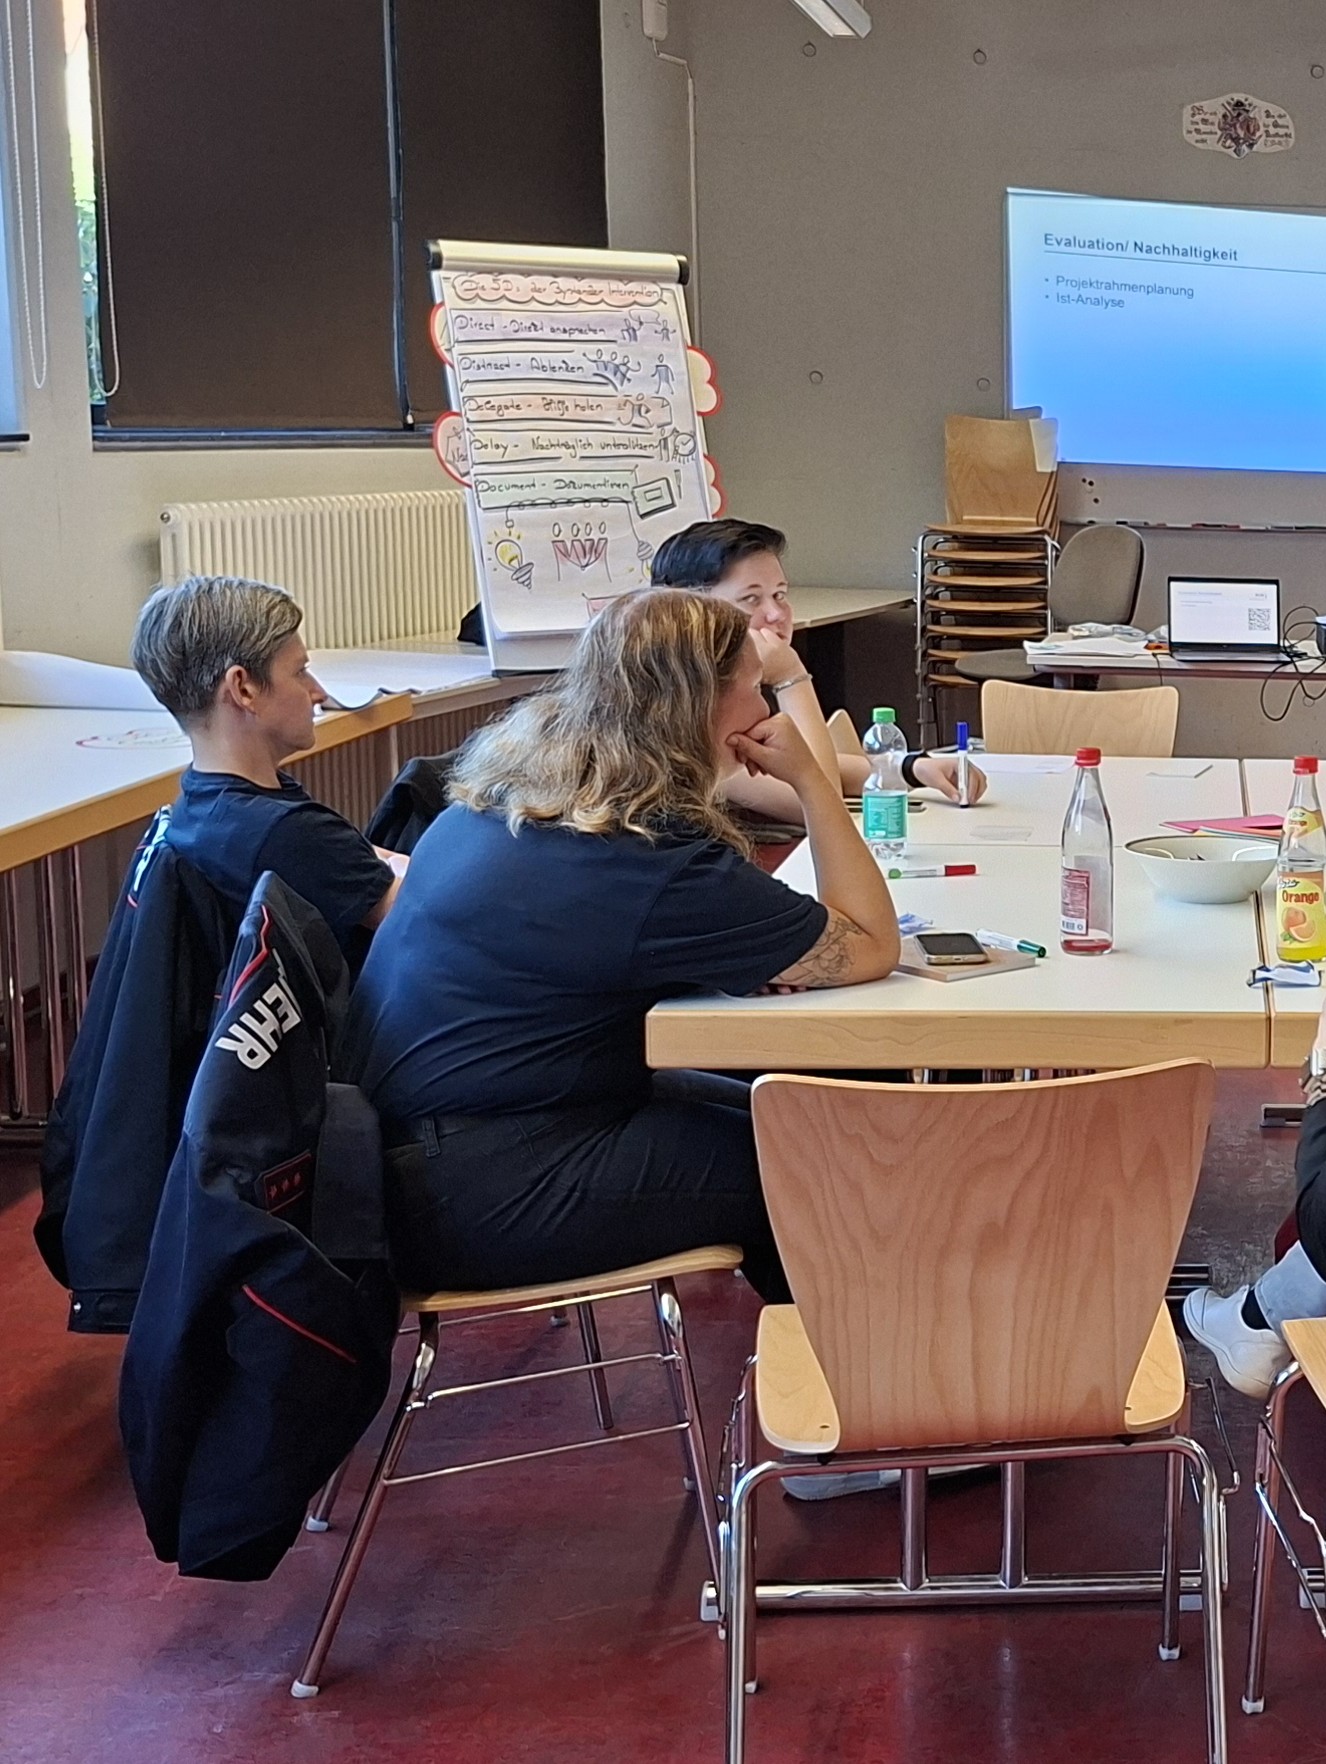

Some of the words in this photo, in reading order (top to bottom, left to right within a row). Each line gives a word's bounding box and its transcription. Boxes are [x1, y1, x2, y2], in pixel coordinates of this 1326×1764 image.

[1044, 233, 1129, 251] Evaluation/
[1133, 240, 1239, 262] Nachhaltigkeit
[1056, 275, 1194, 299] Projektrahmenplanung
[1056, 292, 1125, 309] Ist-Analyse
[453, 314, 495, 331] Direct
[530, 358, 585, 374] Ablenken
[574, 397, 604, 411] holen
[471, 438, 508, 459] Delay
[476, 478, 536, 493] Document
[1282, 890, 1319, 905] Orange
